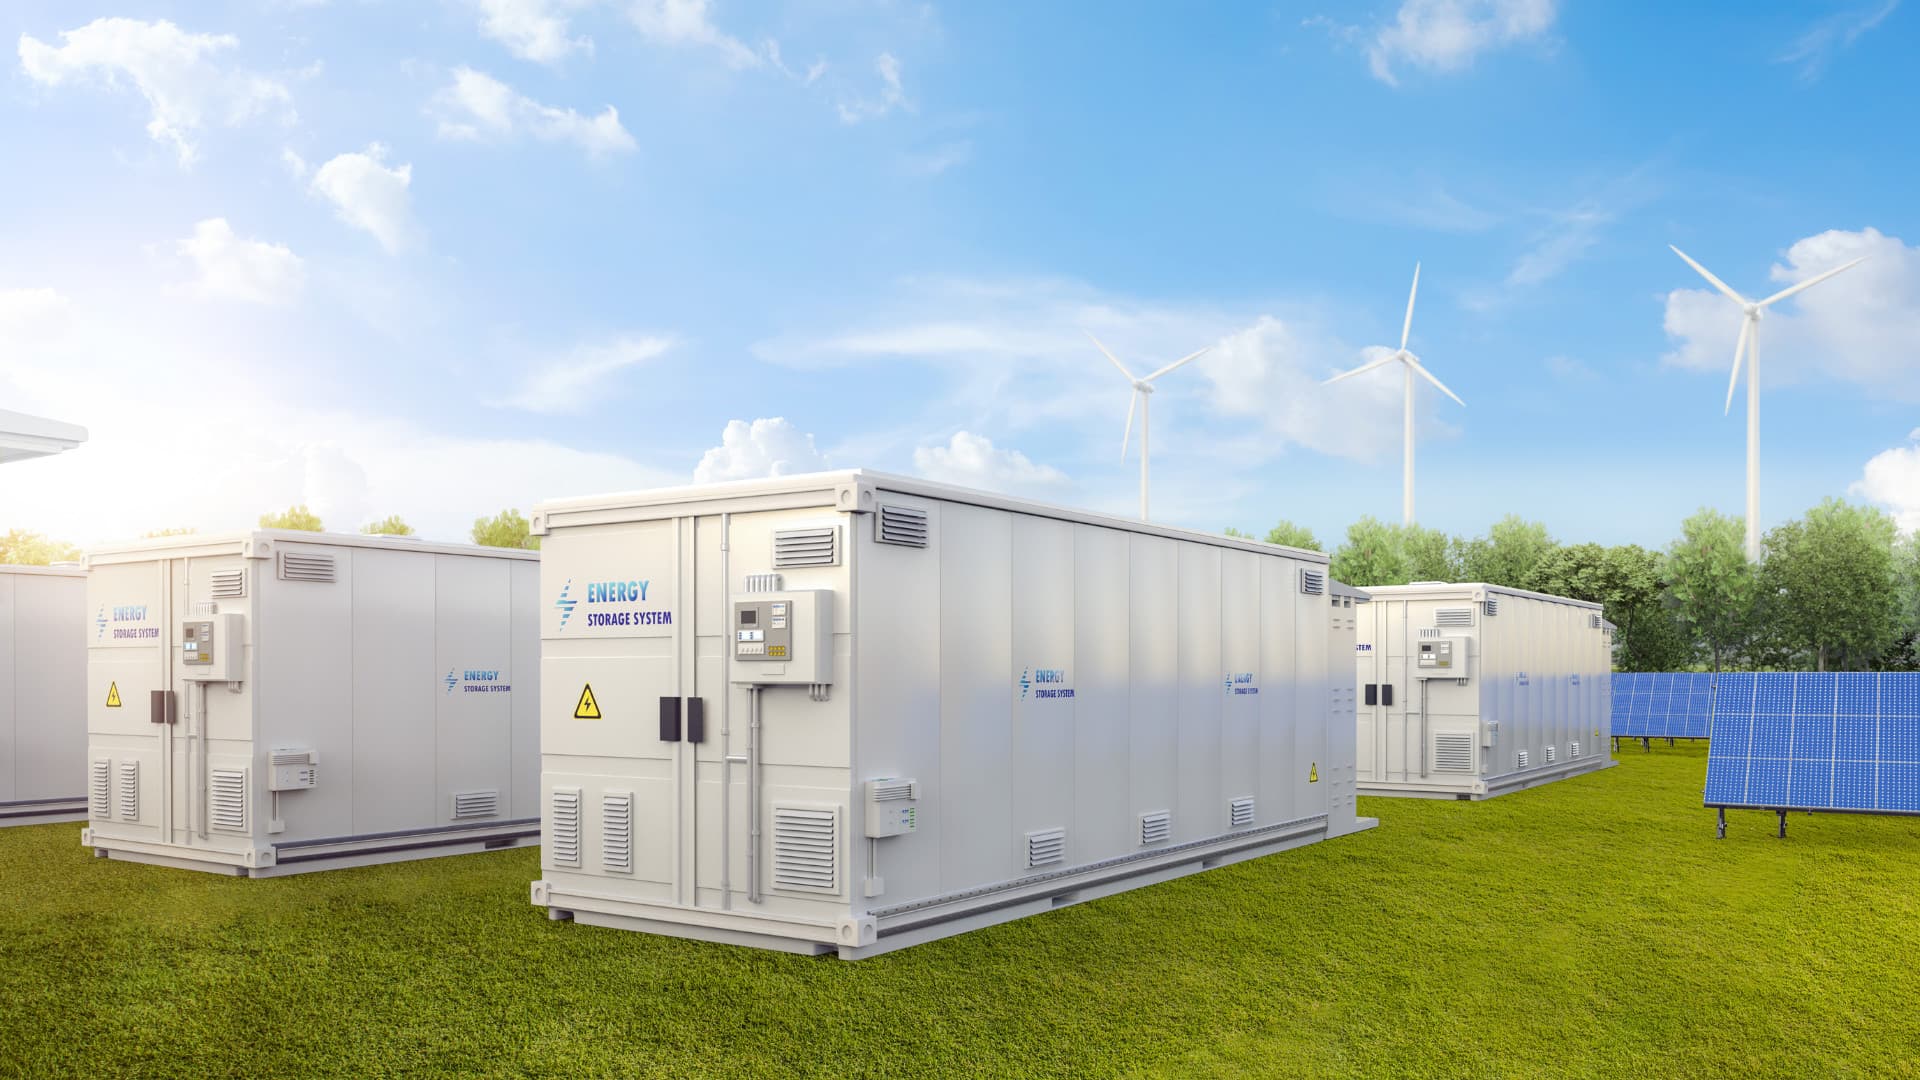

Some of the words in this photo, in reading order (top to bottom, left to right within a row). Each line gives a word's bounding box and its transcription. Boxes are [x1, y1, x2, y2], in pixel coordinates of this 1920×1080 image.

[588, 579, 650, 603] ENERGY
[113, 605, 147, 622] ENERGY
[588, 613, 630, 627] STORAGE
[633, 611, 672, 626] SYSTEM
[113, 628, 137, 639] STORAGE
[138, 628, 159, 639] SYSTEM
[464, 670, 499, 681] ENERGY
[1035, 669, 1064, 683] ENERGY
[464, 685, 489, 693] STORAGE
[1035, 689, 1056, 698] STORAGE
[1057, 689, 1075, 698] SYSTEM
